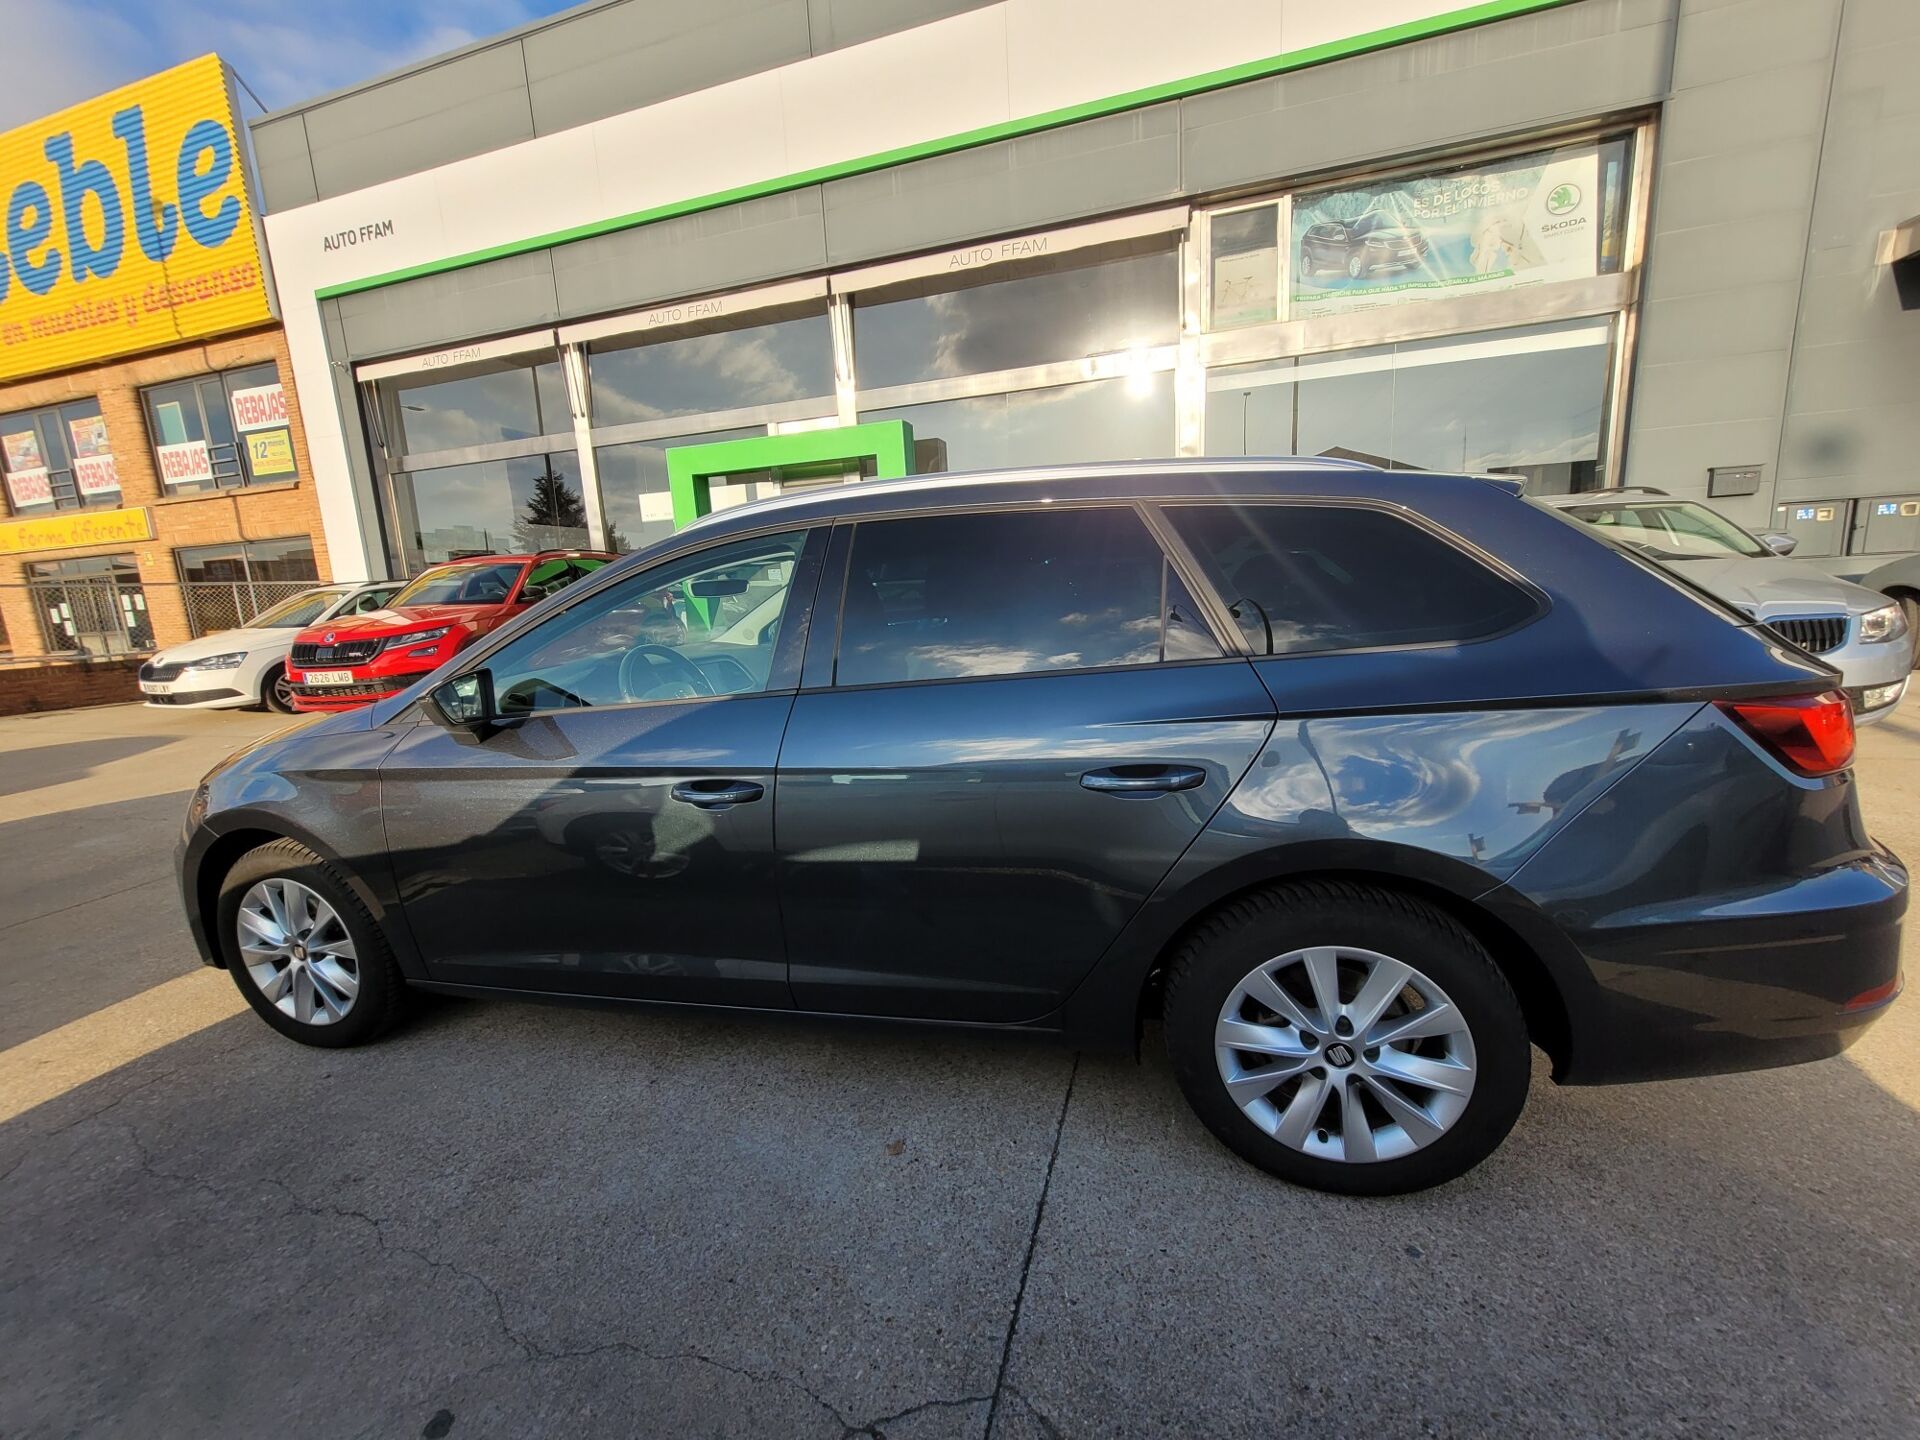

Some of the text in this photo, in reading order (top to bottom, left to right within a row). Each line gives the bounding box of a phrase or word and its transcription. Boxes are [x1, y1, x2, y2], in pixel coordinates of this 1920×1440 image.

[0, 104, 242, 302] eble
[1414, 197, 1430, 209] ES
[1434, 191, 1452, 206] DE
[1455, 180, 1501, 201] LOCOS
[1414, 208, 1441, 219] POR
[324, 219, 394, 252] AUTO FFAM
[948, 237, 1048, 268] AUTO FFAM
[142, 262, 257, 313] descanso
[648, 301, 723, 326] AUTO FFAM
[422, 346, 481, 368] AUTO FFAM
[235, 390, 287, 425] REBAJAS
[162, 447, 209, 478] REBAJAS
[252, 441, 268, 460] 12
[18, 527, 67, 550] forma
[70, 514, 145, 543] diferente
[309, 672, 350, 683] 2626 LMB
